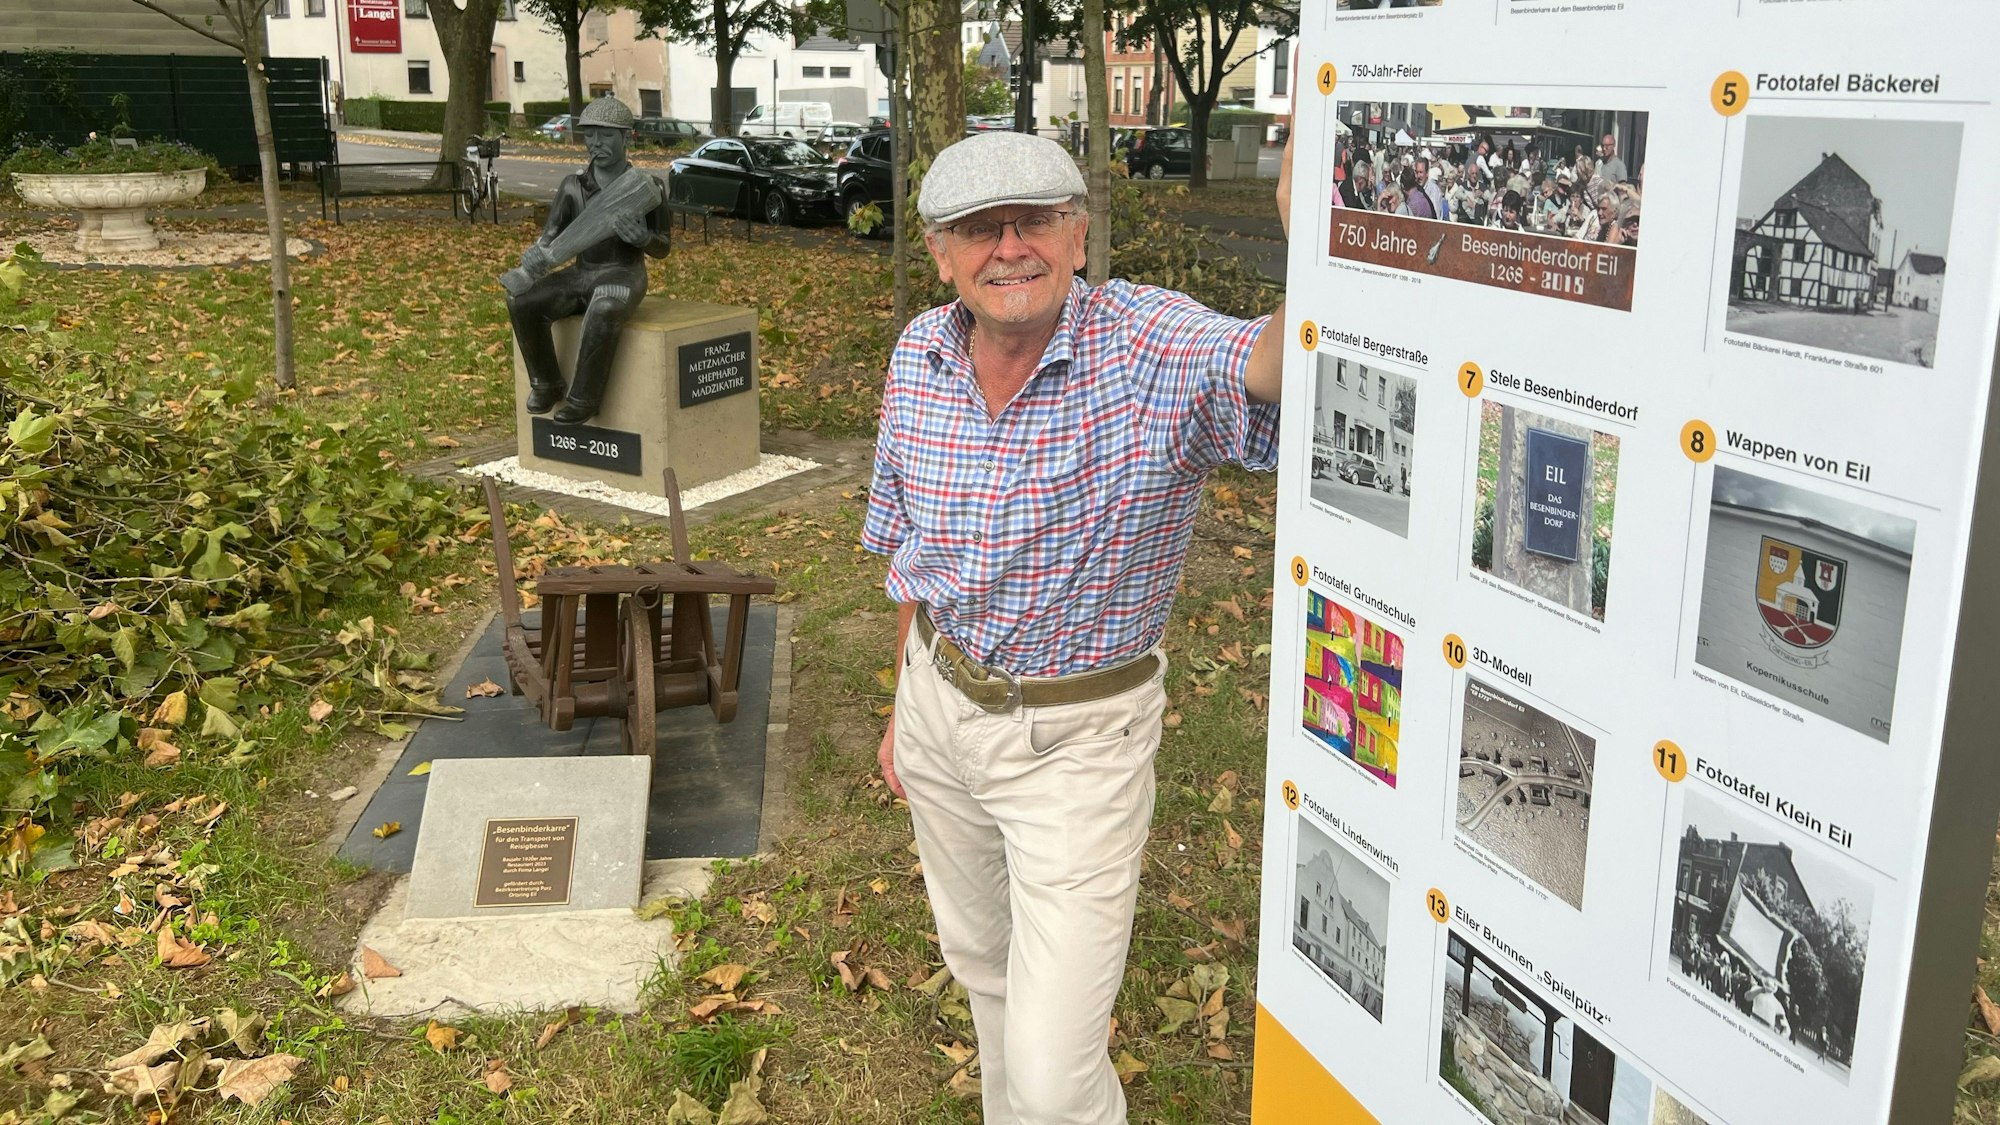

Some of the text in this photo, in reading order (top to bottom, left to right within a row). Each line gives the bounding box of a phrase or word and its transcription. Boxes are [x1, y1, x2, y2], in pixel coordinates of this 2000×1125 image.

[359, 8, 395, 21] Langel
[1323, 64, 1422, 87] 4 750-Jahr-Feier
[1722, 73, 1940, 107] 5 Fototafel Bäckerei
[1339, 222, 1417, 256] 750 Jahre
[1461, 233, 1618, 276] Besenbinderdorf Eil
[1490, 262, 1524, 284] 1268
[1541, 270, 1585, 295] 2018
[689, 351, 746, 373] METZMACHER
[704, 342, 731, 357] FRANZ
[1305, 325, 1428, 365] 6 Fototafel Bergerstraße
[1724, 337, 1751, 348] Fototafel
[1752, 342, 1780, 354] Bäckerei
[1804, 352, 1842, 366] Frankfurter
[1844, 359, 1868, 371] Straße
[1870, 366, 1883, 374] 601
[691, 376, 744, 399] MADZIKATIRE
[697, 366, 738, 385] SHEPHARD
[1466, 369, 1638, 421] 7 Stele Besenbinderdorf
[550, 434, 577, 450] 1268
[589, 440, 619, 458] 2018
[1691, 429, 1871, 483] 8 Wappen von Eil
[1545, 464, 1567, 485] EIL
[1530, 501, 1579, 520] BESENBINDER-
[1547, 493, 1562, 504] DAS
[1544, 516, 1564, 528] DORF
[1296, 563, 1416, 628] 9 Fototafel Grundschule
[1446, 641, 1532, 687] 10 3D-Modell
[1692, 668, 1717, 685] Wappen
[1717, 679, 1729, 690] von
[1740, 689, 1780, 713] Düsseldorfer
[1782, 708, 1804, 723] Straße
[1746, 660, 1830, 705] Kopernikusschule
[1657, 747, 1852, 849] 11 Fototafel Klein Eil
[493, 824, 570, 834] „Besenbinderkarre“
[520, 835, 551, 844] Transport
[1285, 786, 1399, 873] 12 Fototafel Lindenwirtin
[1429, 893, 1612, 1025] 13 Eiler Brunnen „Spielpütz“
[1666, 976, 1691, 999] Fototafel
[1722, 1012, 1738, 1029] Klein
[1748, 1031, 1783, 1058] Frankfurter
[1783, 1055, 1805, 1074] Straße
